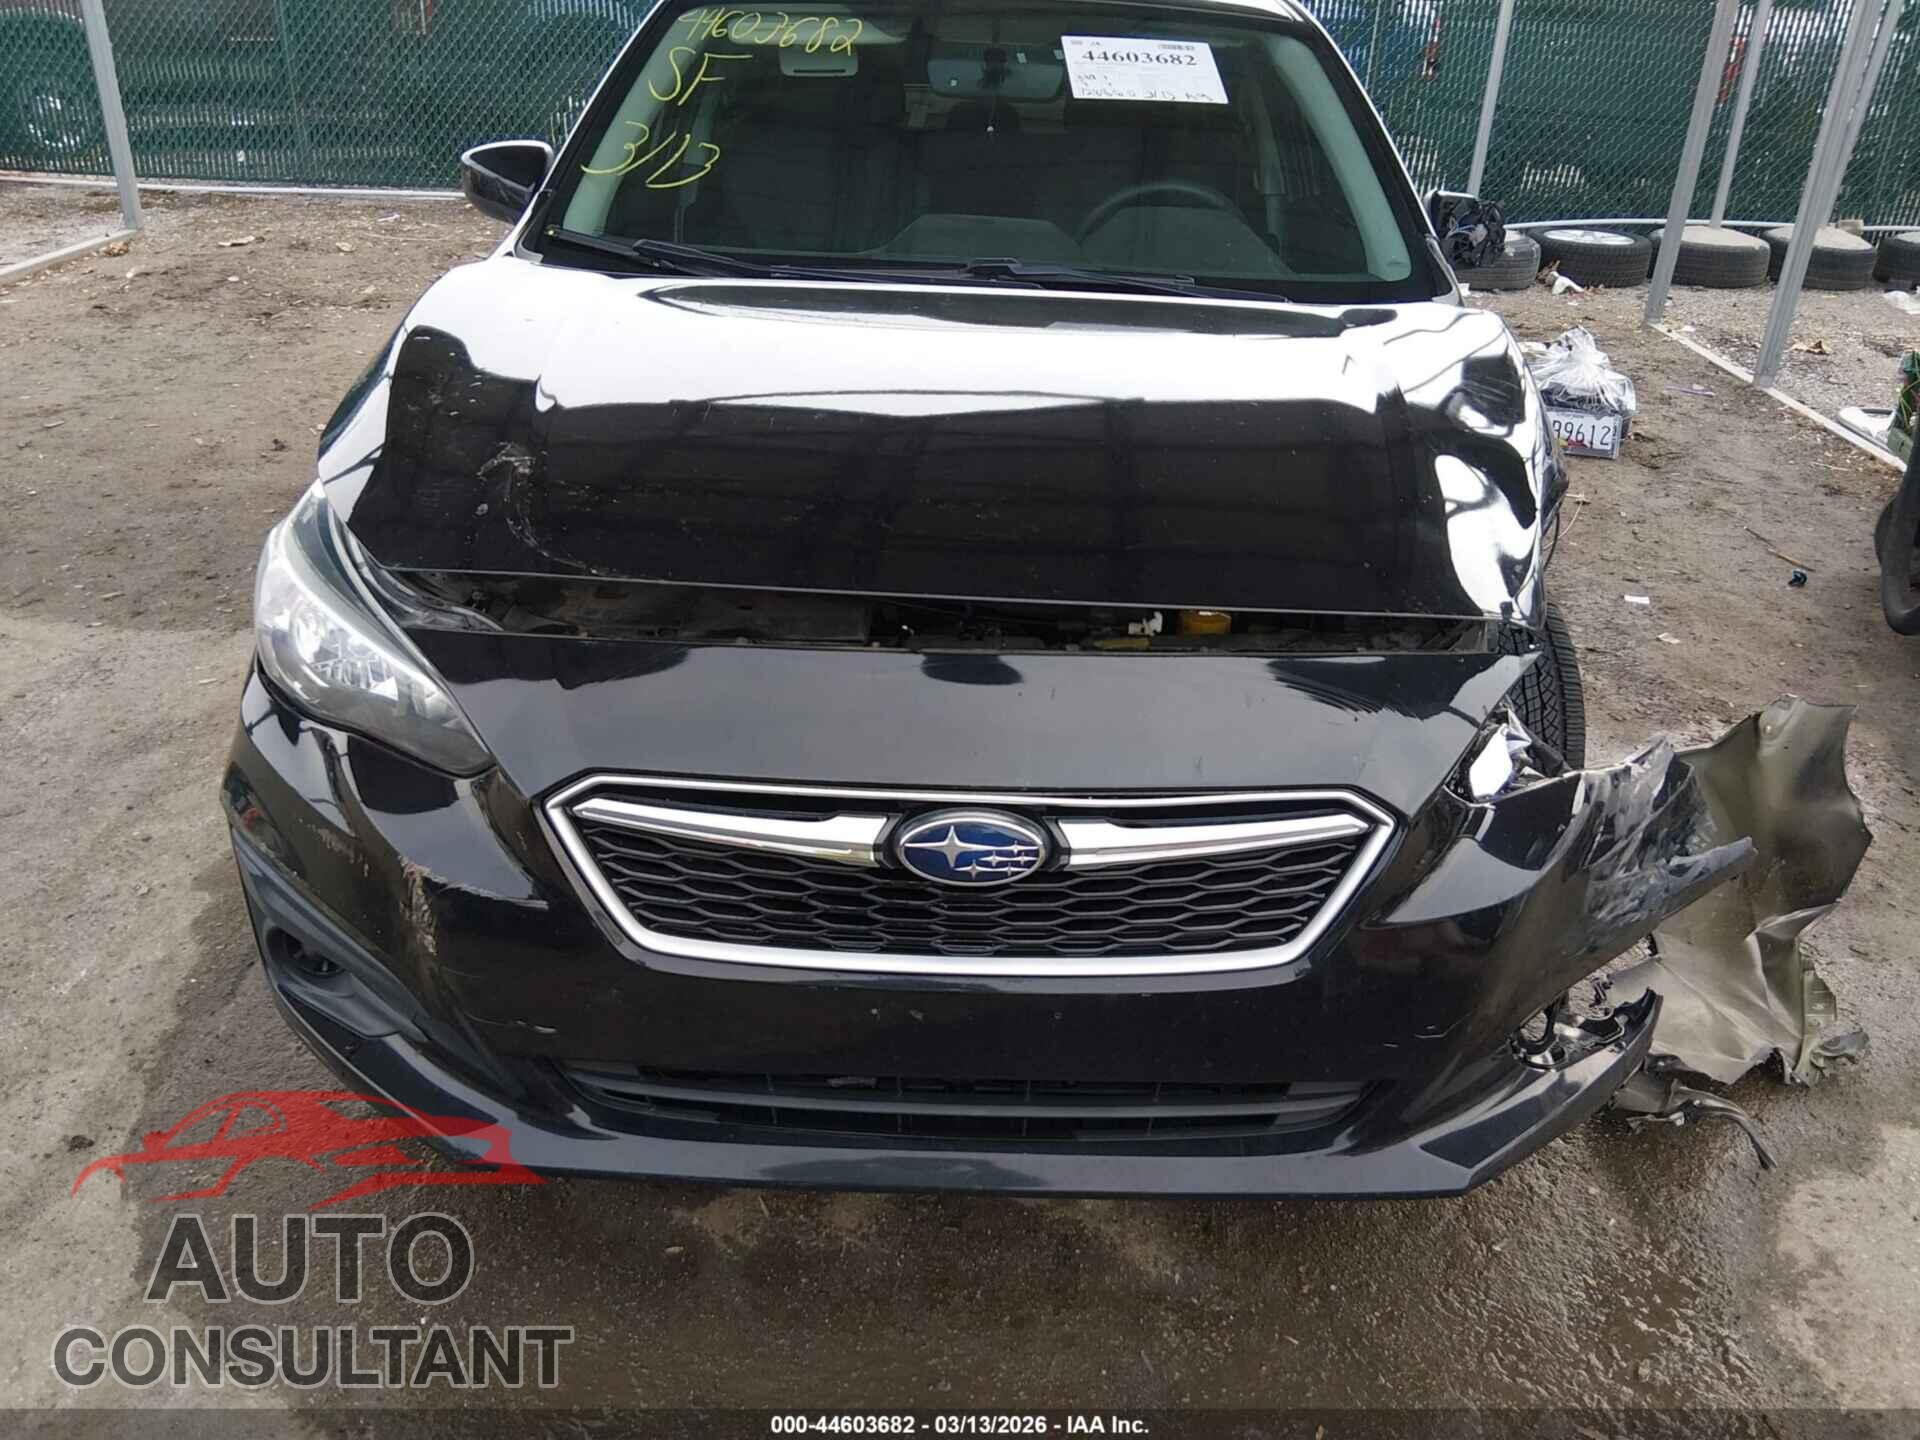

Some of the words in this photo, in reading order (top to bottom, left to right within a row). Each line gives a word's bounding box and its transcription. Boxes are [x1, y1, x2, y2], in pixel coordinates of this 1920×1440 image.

[678, 7, 864, 56] 44603682
[648, 46, 753, 106] SF
[1081, 50, 1198, 66] 44603682
